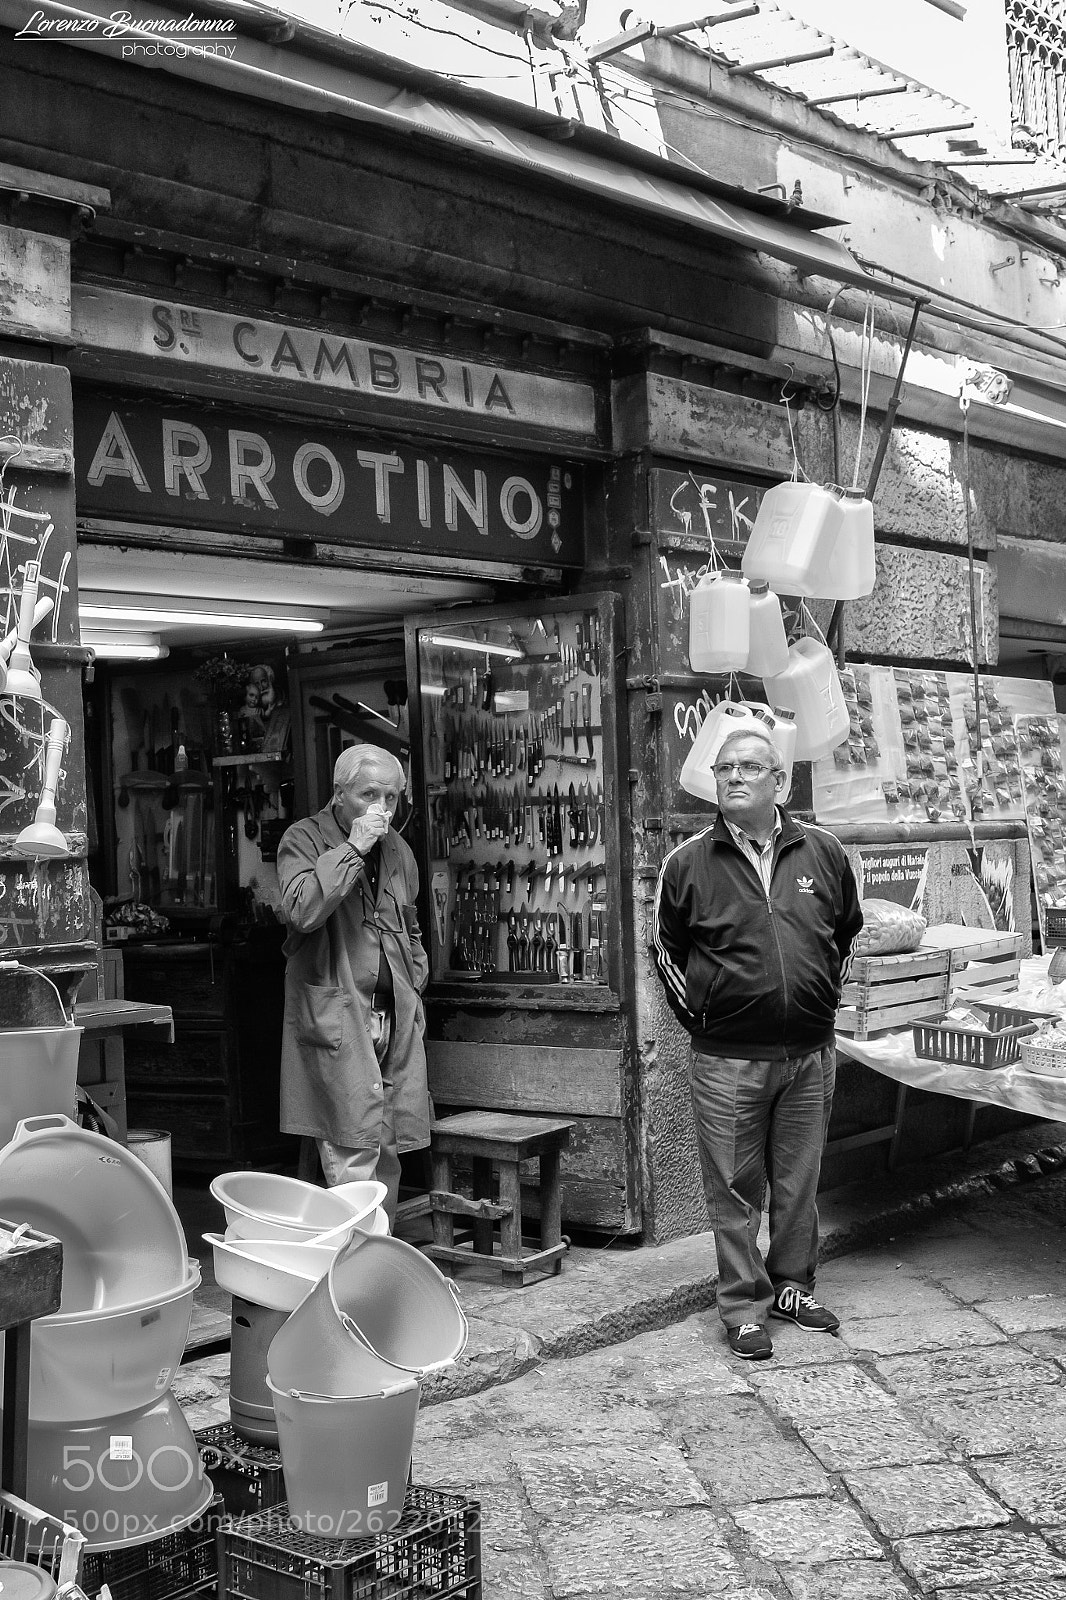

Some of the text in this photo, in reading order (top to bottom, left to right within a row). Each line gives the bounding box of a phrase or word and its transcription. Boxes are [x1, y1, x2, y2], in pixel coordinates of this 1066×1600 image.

[232, 321, 516, 415] CAMBRIA
[87, 410, 543, 540] ARROTINO
[871, 870, 891, 885] popolo
[891, 869, 905, 881] della
[882, 855, 900, 869] auguri
[901, 855, 907, 867] di
